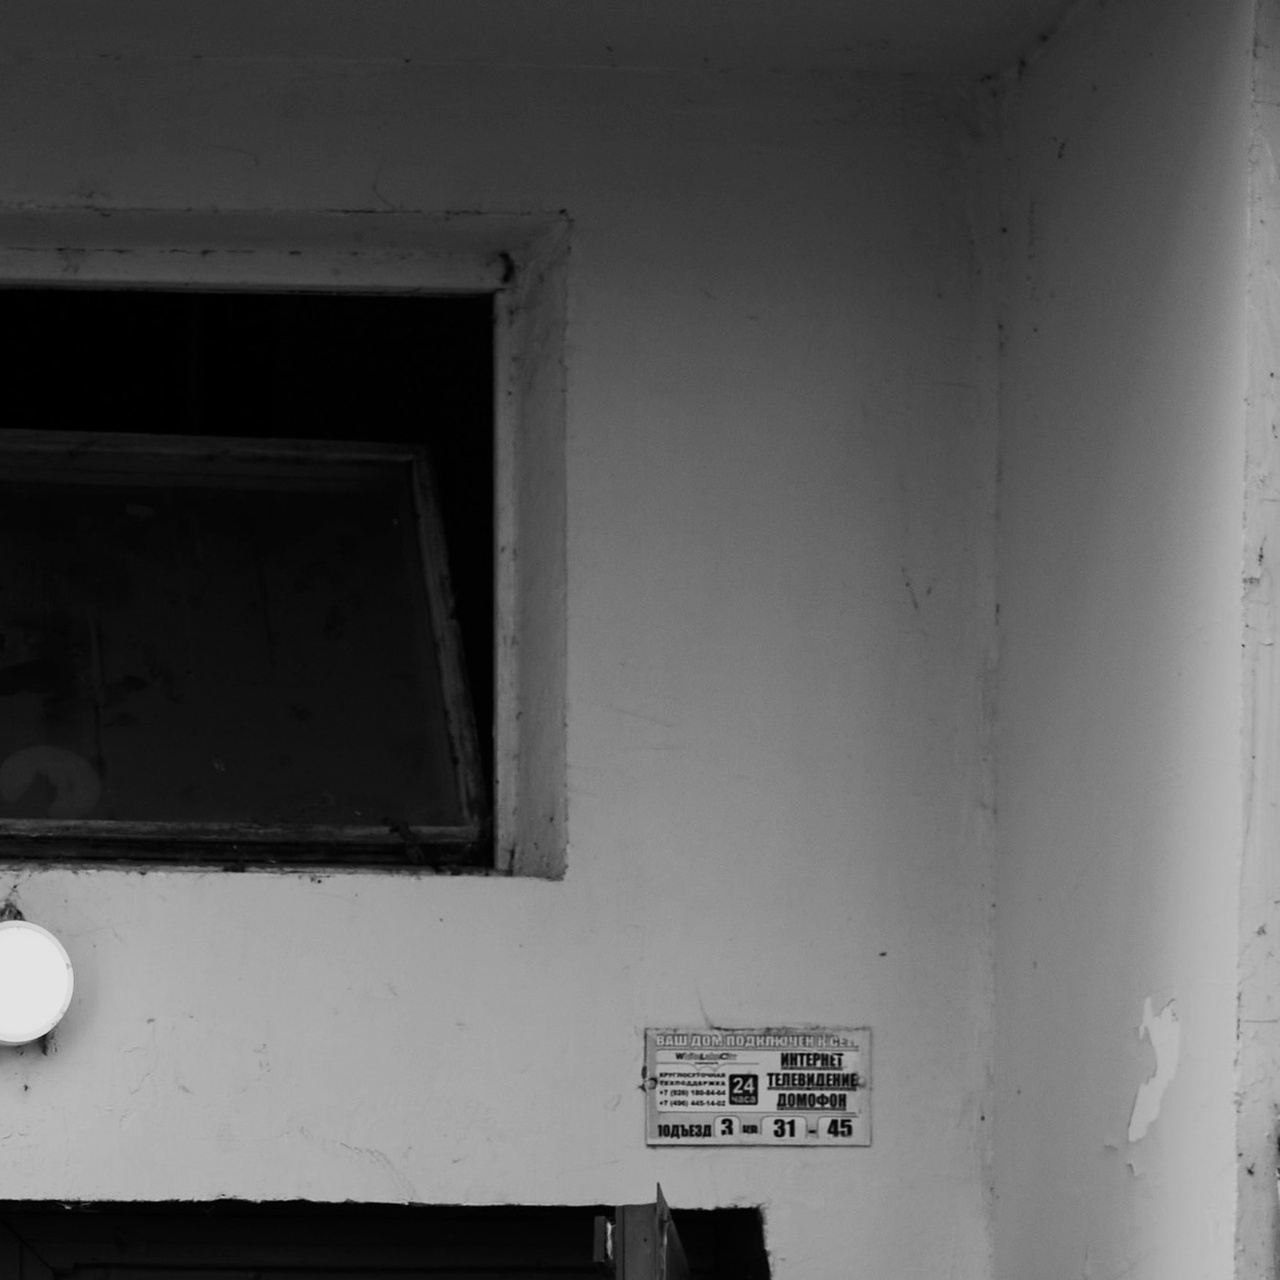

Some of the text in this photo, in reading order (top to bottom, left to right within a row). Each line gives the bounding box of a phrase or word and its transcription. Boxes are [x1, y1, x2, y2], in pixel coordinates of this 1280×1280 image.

[656, 1034, 687, 1046] ВАШ
[691, 1035, 721, 1047] ДОМ
[726, 1034, 815, 1047] ПОДКЛЮЧЕН
[780, 1053, 844, 1067] ИНТЕРНЕТ
[732, 1077, 755, 1094] 24
[767, 1073, 858, 1087] ТЕЛЕВИДЕНИЕ
[777, 1093, 847, 1108] ДОМОФОН
[721, 1118, 733, 1135] 3
[773, 1119, 796, 1137] 31
[827, 1119, 853, 1137] 45
